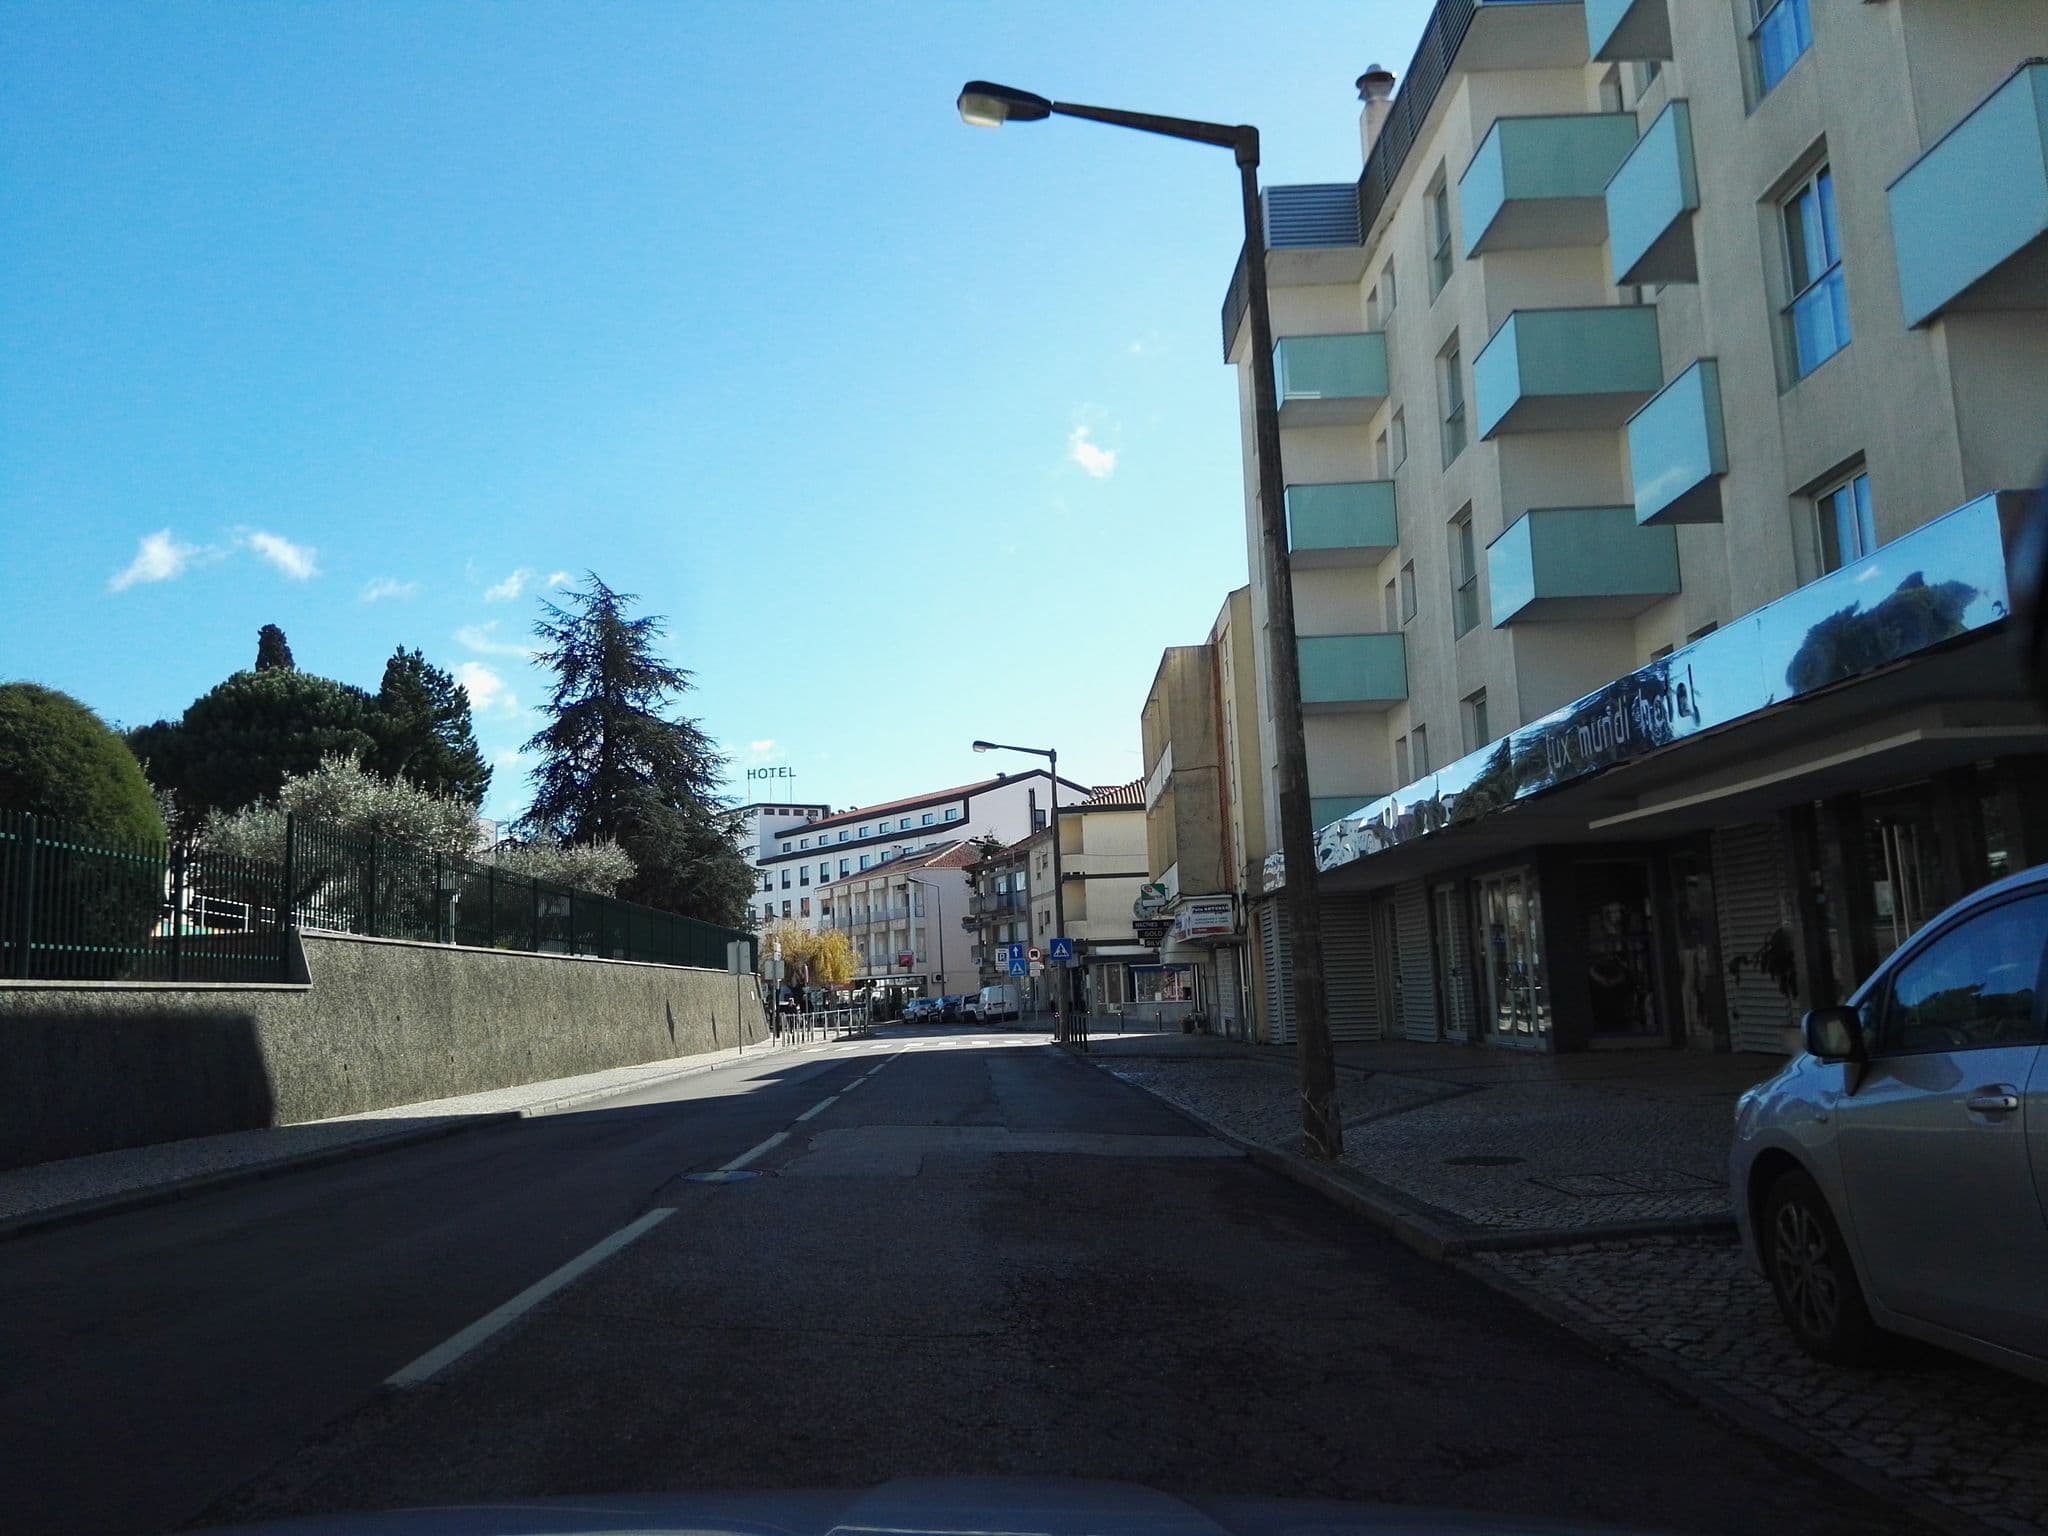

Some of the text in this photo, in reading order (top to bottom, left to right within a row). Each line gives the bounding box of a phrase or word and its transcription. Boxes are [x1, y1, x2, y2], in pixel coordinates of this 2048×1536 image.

[1545, 663, 1701, 771] lux mundi hotel
[747, 766, 797, 780] HOTEL
